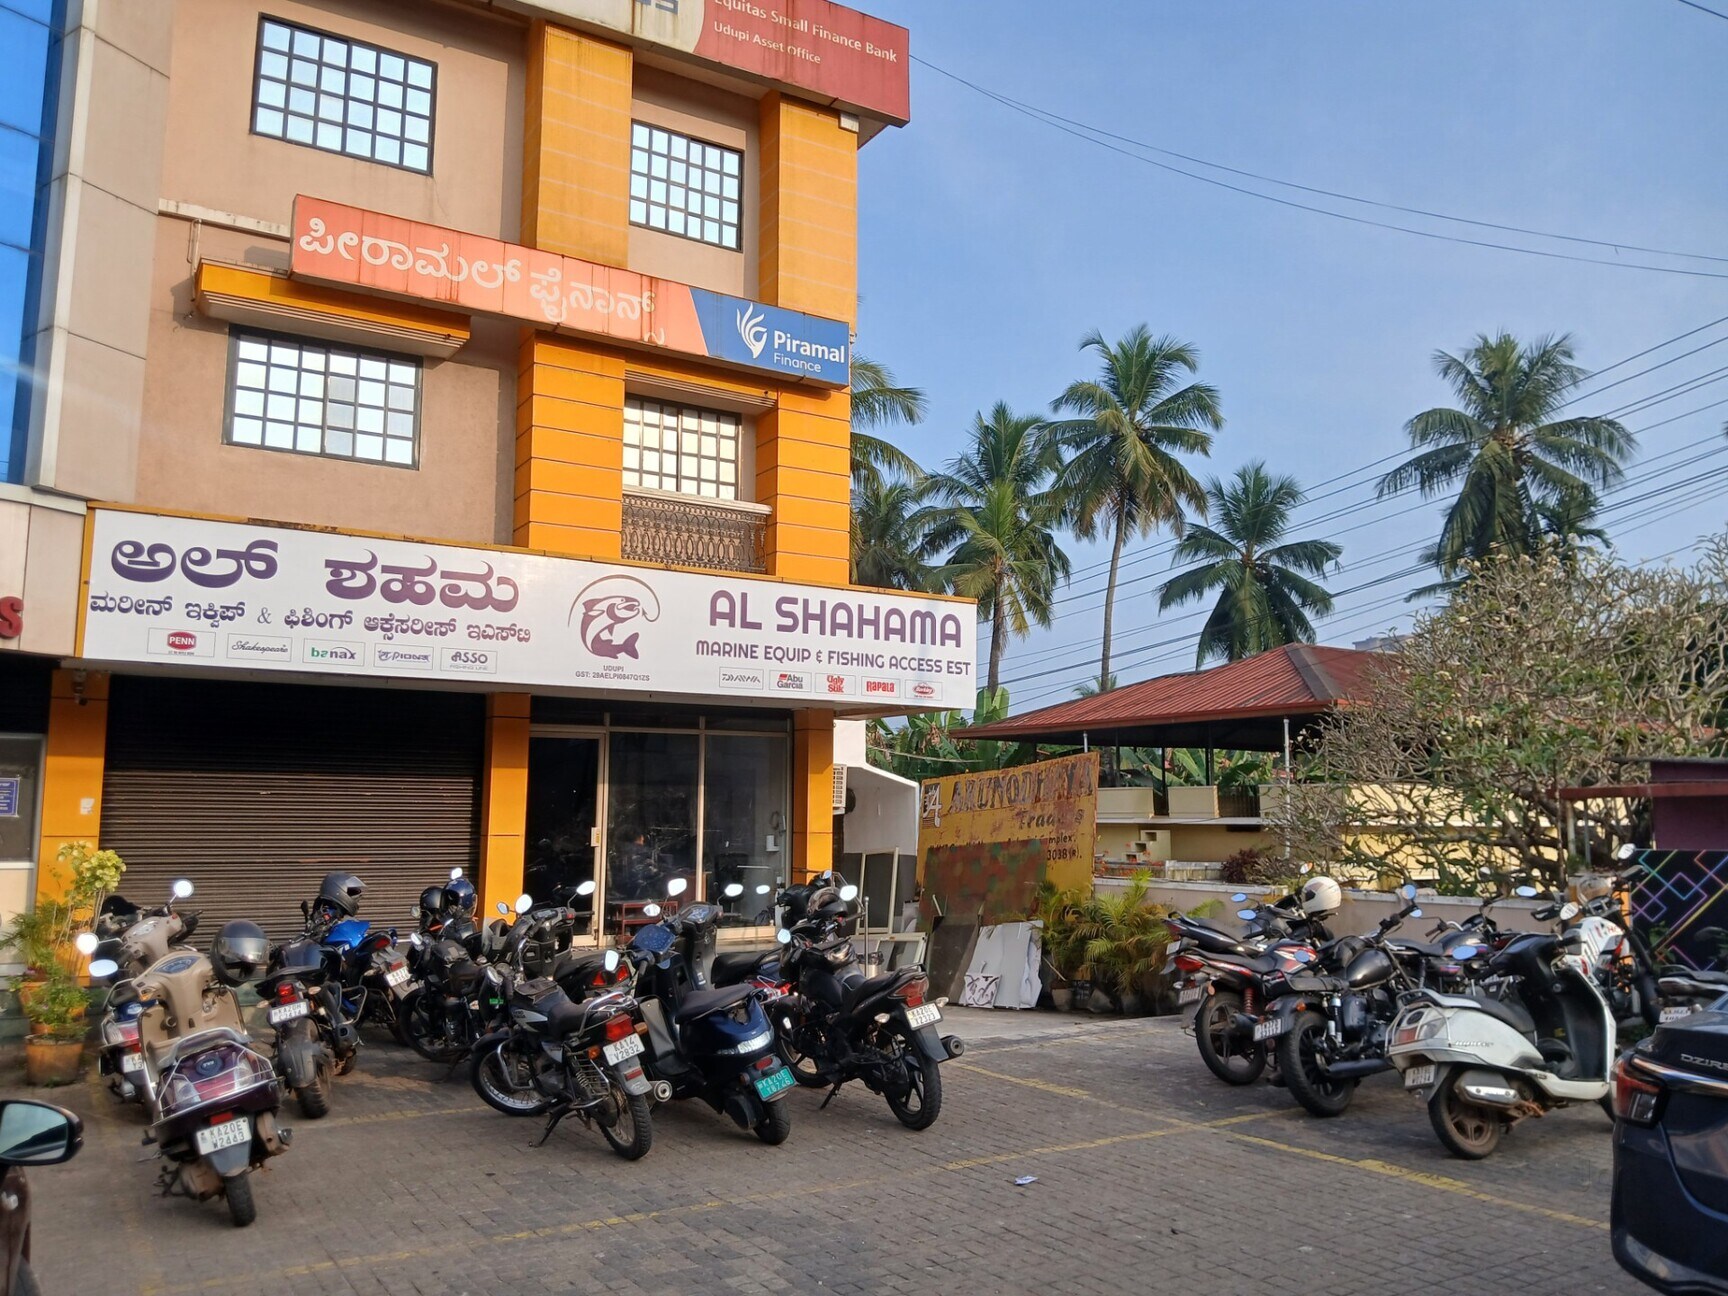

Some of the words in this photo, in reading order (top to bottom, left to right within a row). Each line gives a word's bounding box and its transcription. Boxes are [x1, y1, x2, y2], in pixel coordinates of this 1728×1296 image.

[714, 21, 750, 42] Udupi
[752, 34, 784, 53] Asset
[787, 45, 821, 64] Office
[771, 10, 808, 33] Small
[812, 24, 862, 51] Finance
[865, 42, 897, 63] Bank
[299, 217, 522, 289] ಪೀರಾಮಲ್
[773, 331, 845, 363] Piramal
[773, 353, 822, 373] Finance
[111, 539, 279, 588] ಅಲ್
[324, 548, 520, 613] ಶಹಮ
[90, 591, 173, 616] ಮರೀನ್
[184, 601, 246, 628] ಇಕ್ವಿಪ್
[257, 607, 273, 625] &
[284, 607, 354, 630] ಫಿಶಿಂಗ್
[709, 590, 762, 630] AL
[775, 595, 962, 648] SHAHAMA
[168, 636, 195, 646] PENN
[231, 640, 289, 655] Shakespeare
[311, 647, 356, 661] banax
[450, 651, 488, 664] ASSO
[696, 639, 759, 660] MARINE
[764, 645, 811, 664] EQUIP
[828, 650, 885, 669] FISHING
[889, 655, 943, 674] ACCESS
[947, 660, 971, 676] EST
[575, 670, 591, 678] GST:
[603, 664, 624, 672] UDUPI
[777, 680, 803, 689] Garcia
[787, 674, 803, 682] Abu
[827, 675, 845, 685] Ugly
[1048, 832, 1076, 846] mplex.
[210, 1120, 242, 1139] KA20E
